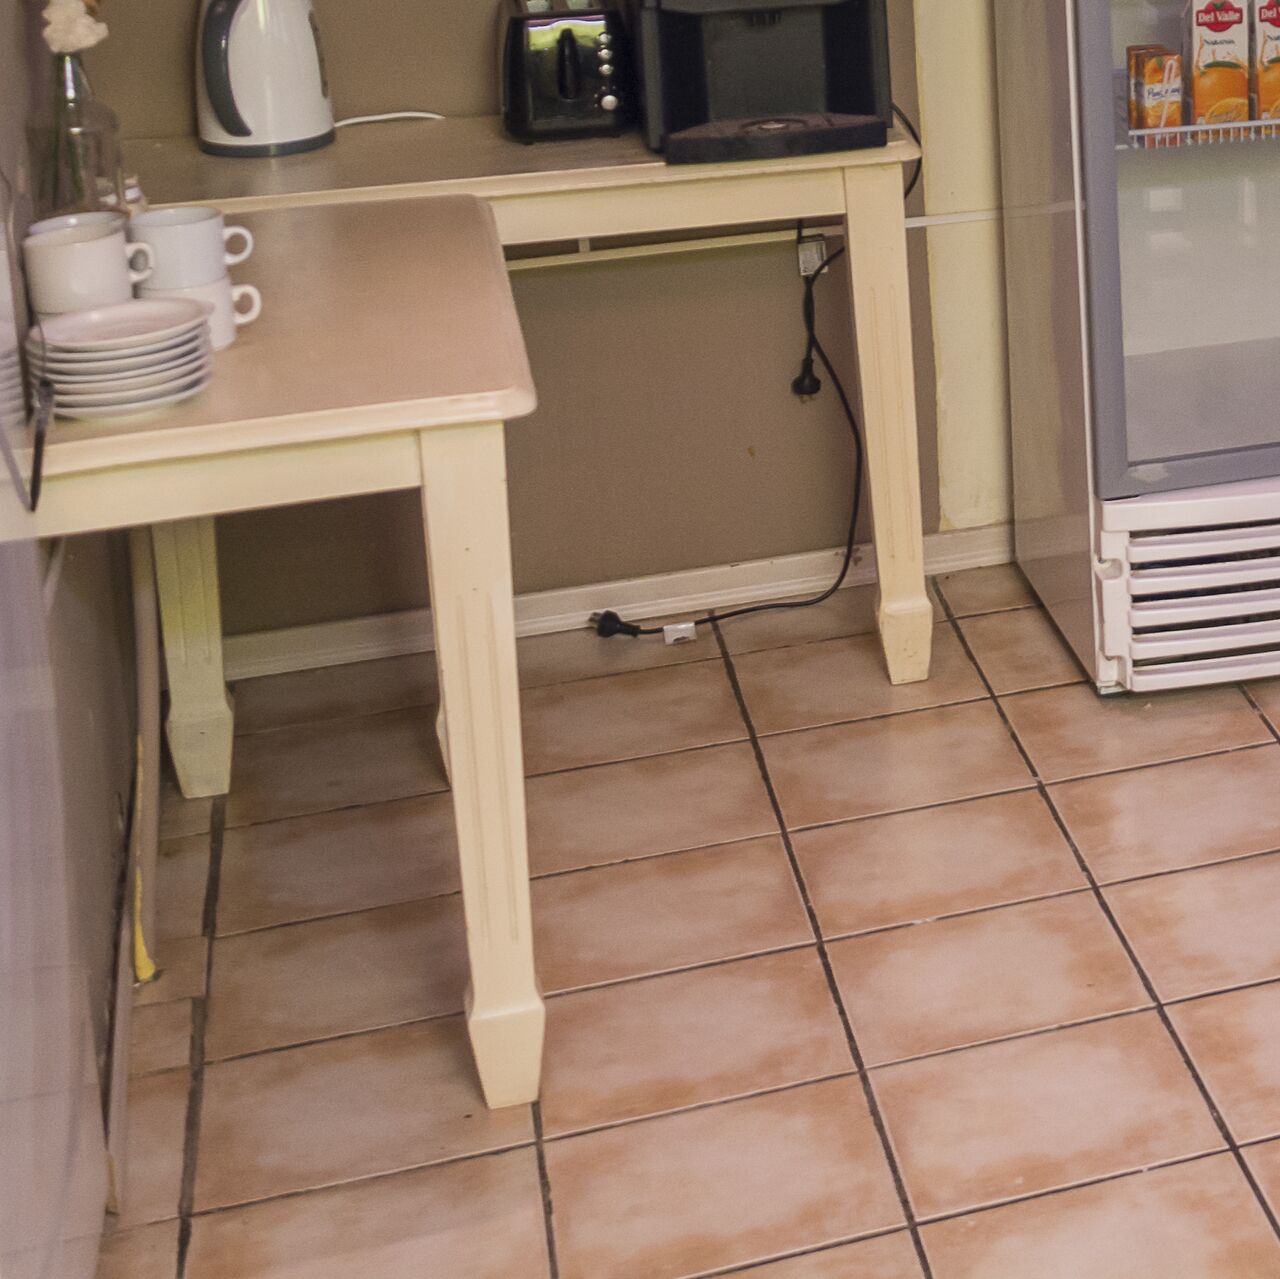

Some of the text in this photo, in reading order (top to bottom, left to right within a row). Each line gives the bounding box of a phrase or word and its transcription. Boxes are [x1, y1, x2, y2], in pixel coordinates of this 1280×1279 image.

[1198, 10, 1240, 23] Del Valle
[1261, 8, 1277, 19] Del
